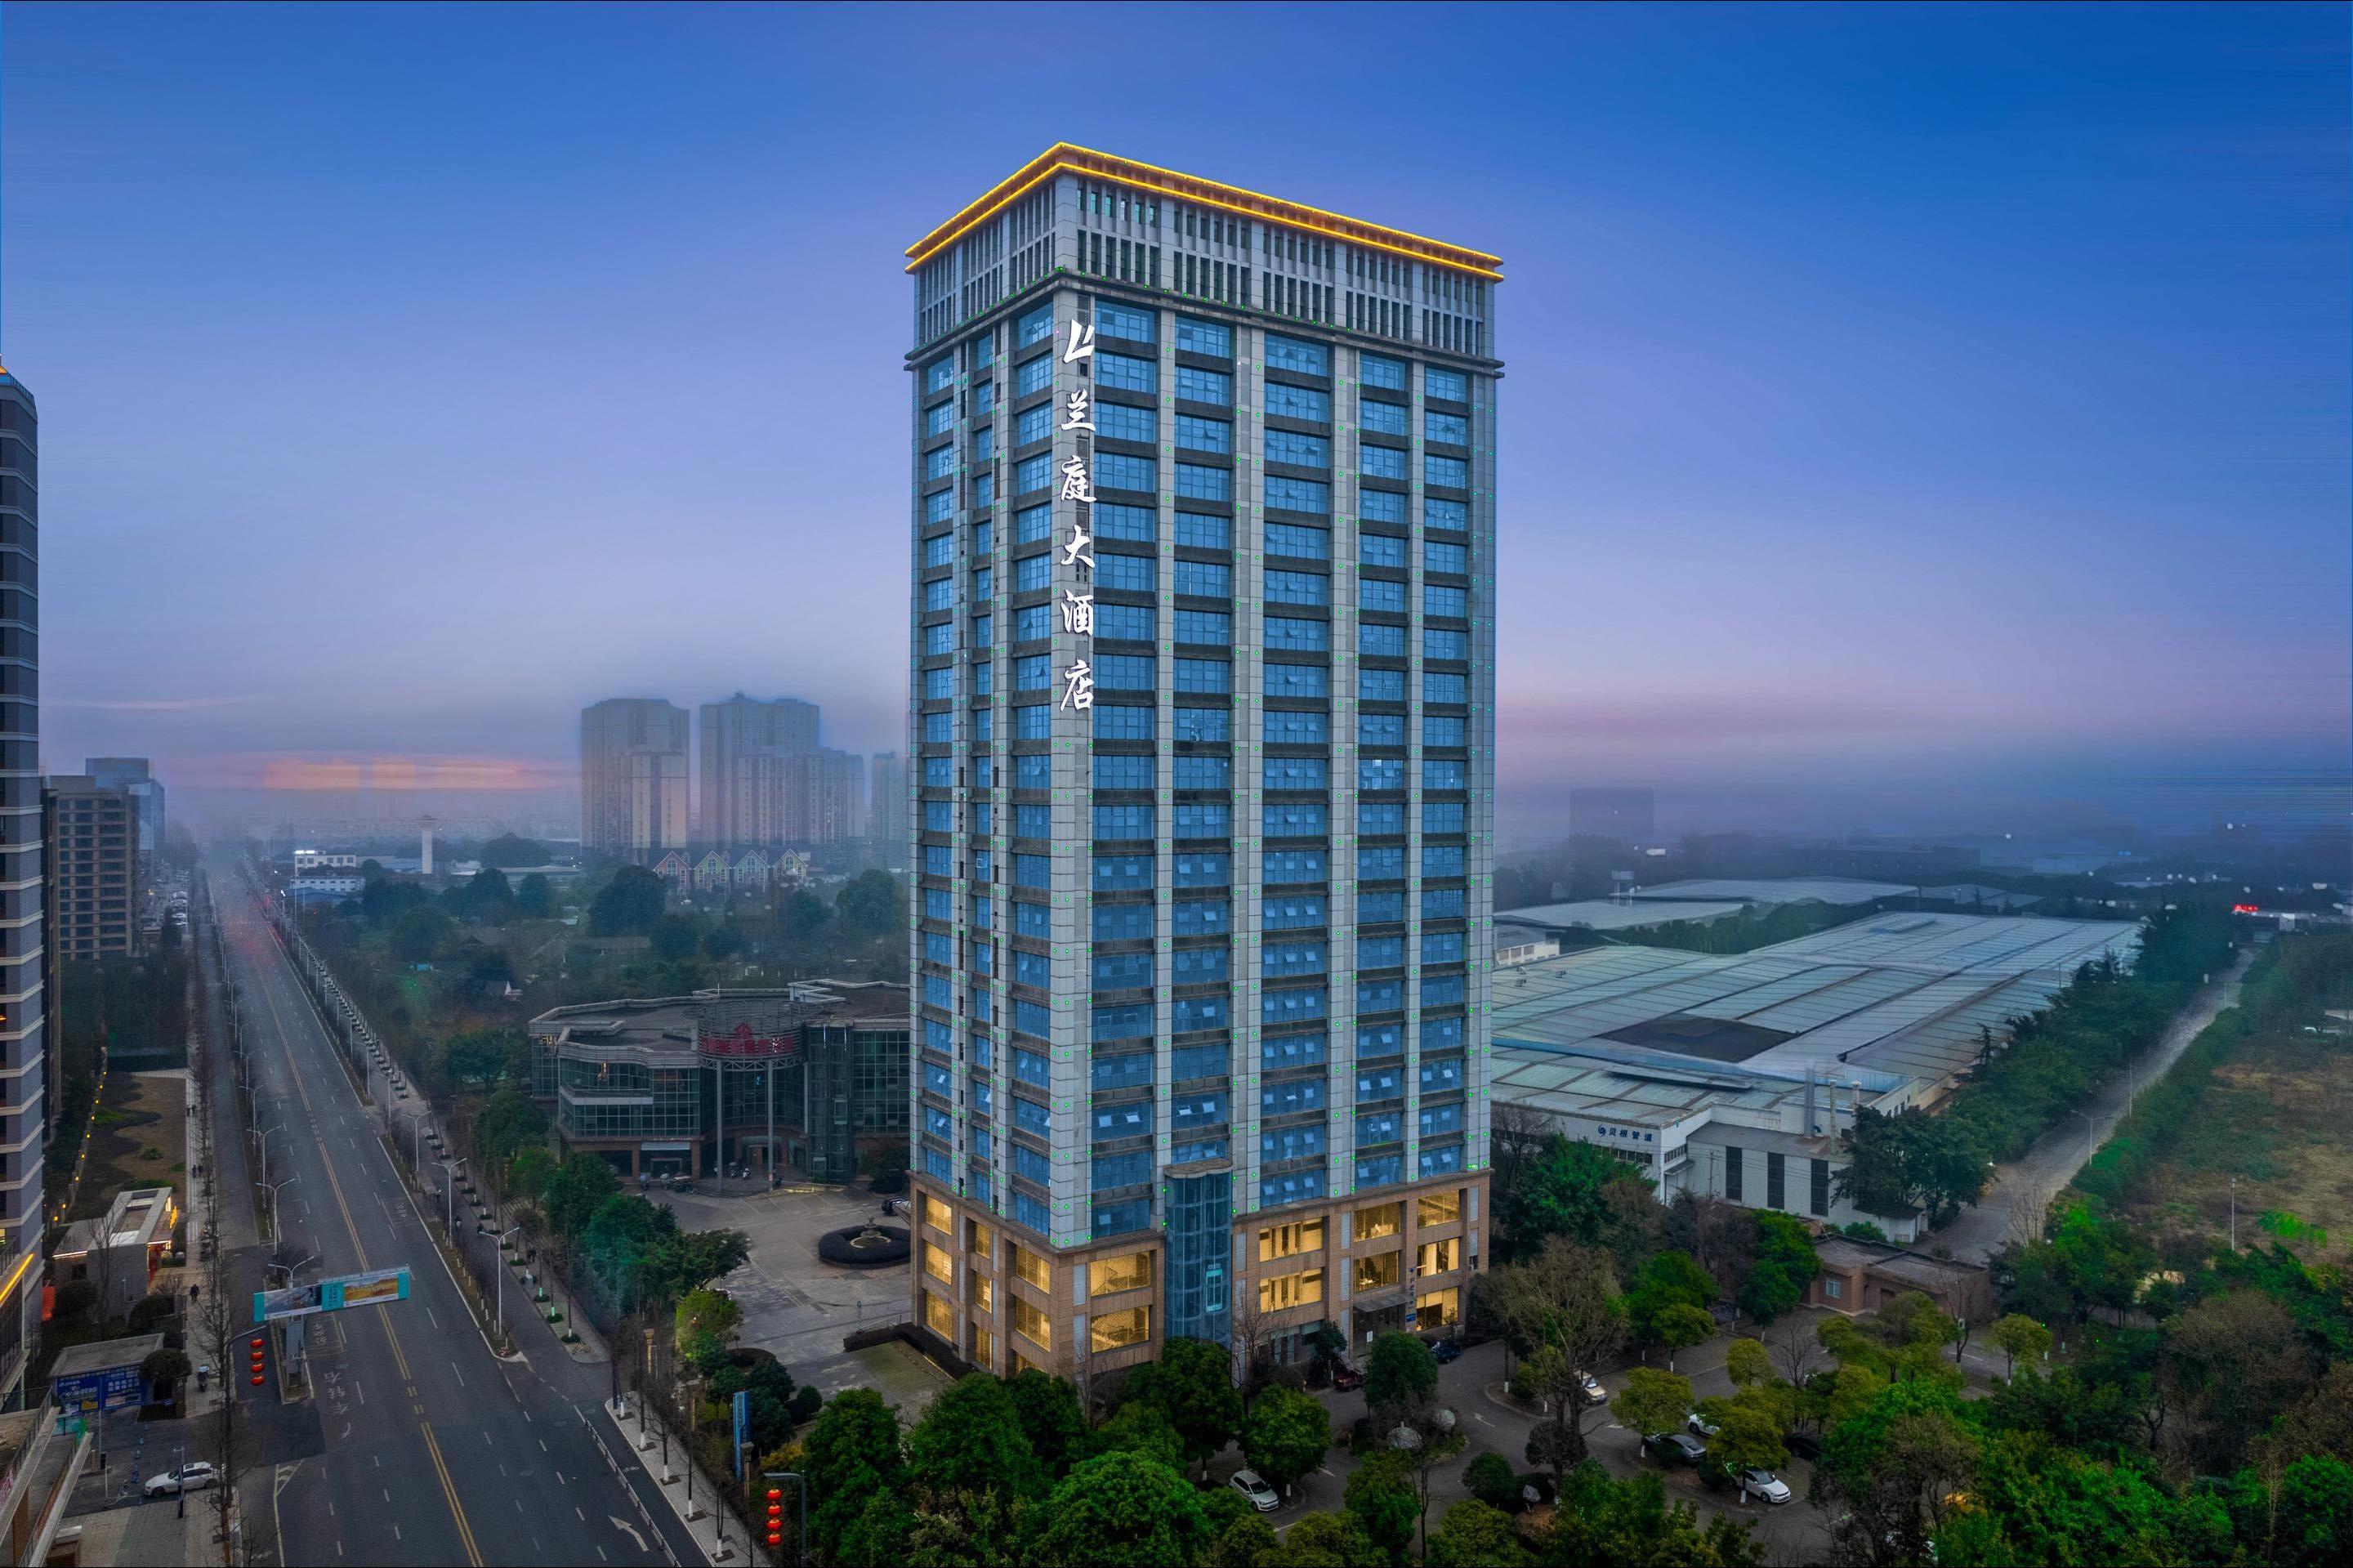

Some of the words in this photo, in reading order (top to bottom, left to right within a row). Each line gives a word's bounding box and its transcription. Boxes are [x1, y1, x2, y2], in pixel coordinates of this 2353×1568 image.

[1060, 387, 1097, 712] 兰庭大酒店
